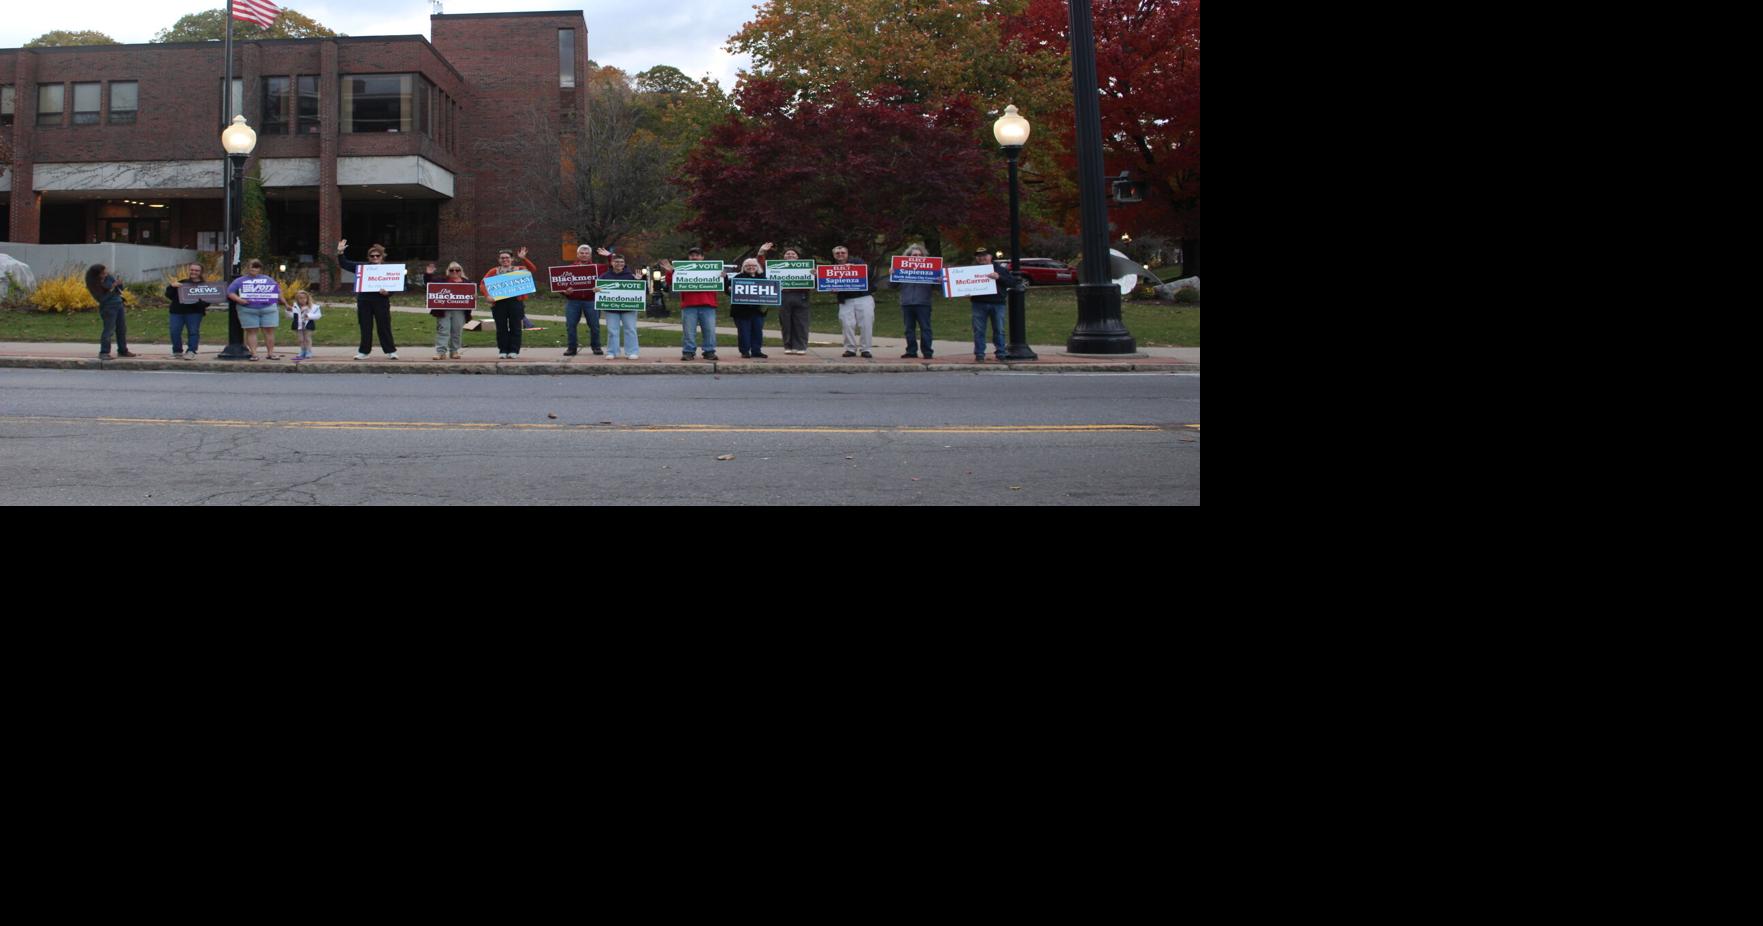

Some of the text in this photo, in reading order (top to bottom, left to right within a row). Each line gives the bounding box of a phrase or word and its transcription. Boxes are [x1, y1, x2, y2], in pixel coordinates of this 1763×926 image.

[901, 260, 933, 270] Bryan
[826, 269, 858, 278] Bryan
[551, 275, 598, 283] Blackmer
[734, 284, 778, 296] RIEHL
